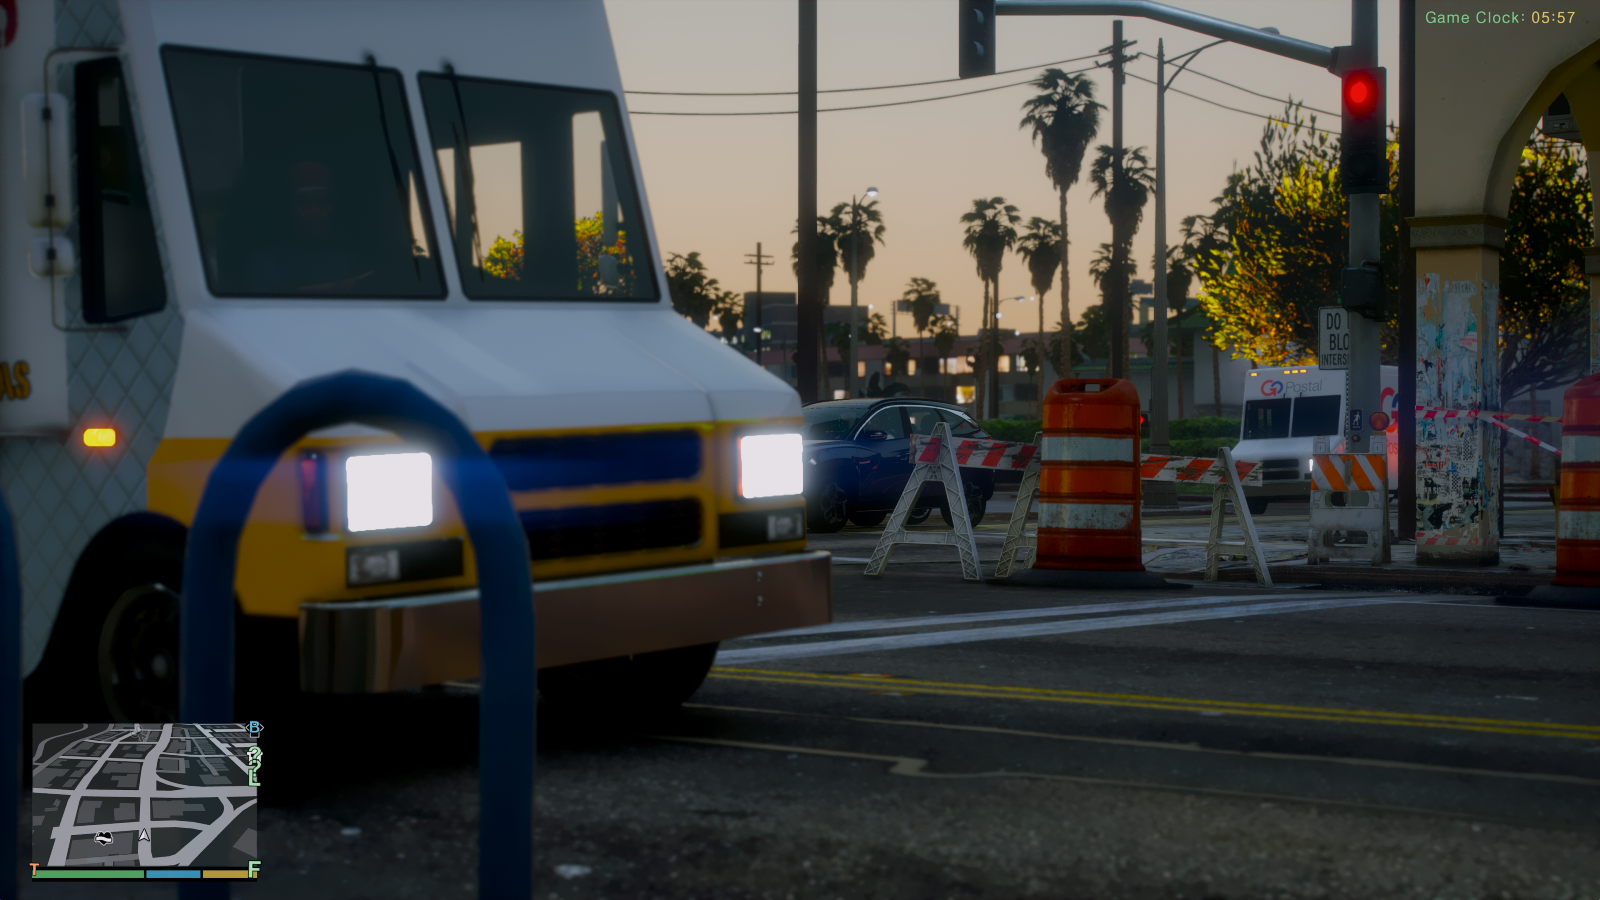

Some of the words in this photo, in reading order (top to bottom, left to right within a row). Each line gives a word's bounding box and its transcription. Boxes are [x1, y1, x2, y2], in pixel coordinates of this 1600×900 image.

[1326, 312, 1341, 330] DO
[1321, 353, 1349, 366] INTERS
[1285, 380, 1323, 394] Postal
